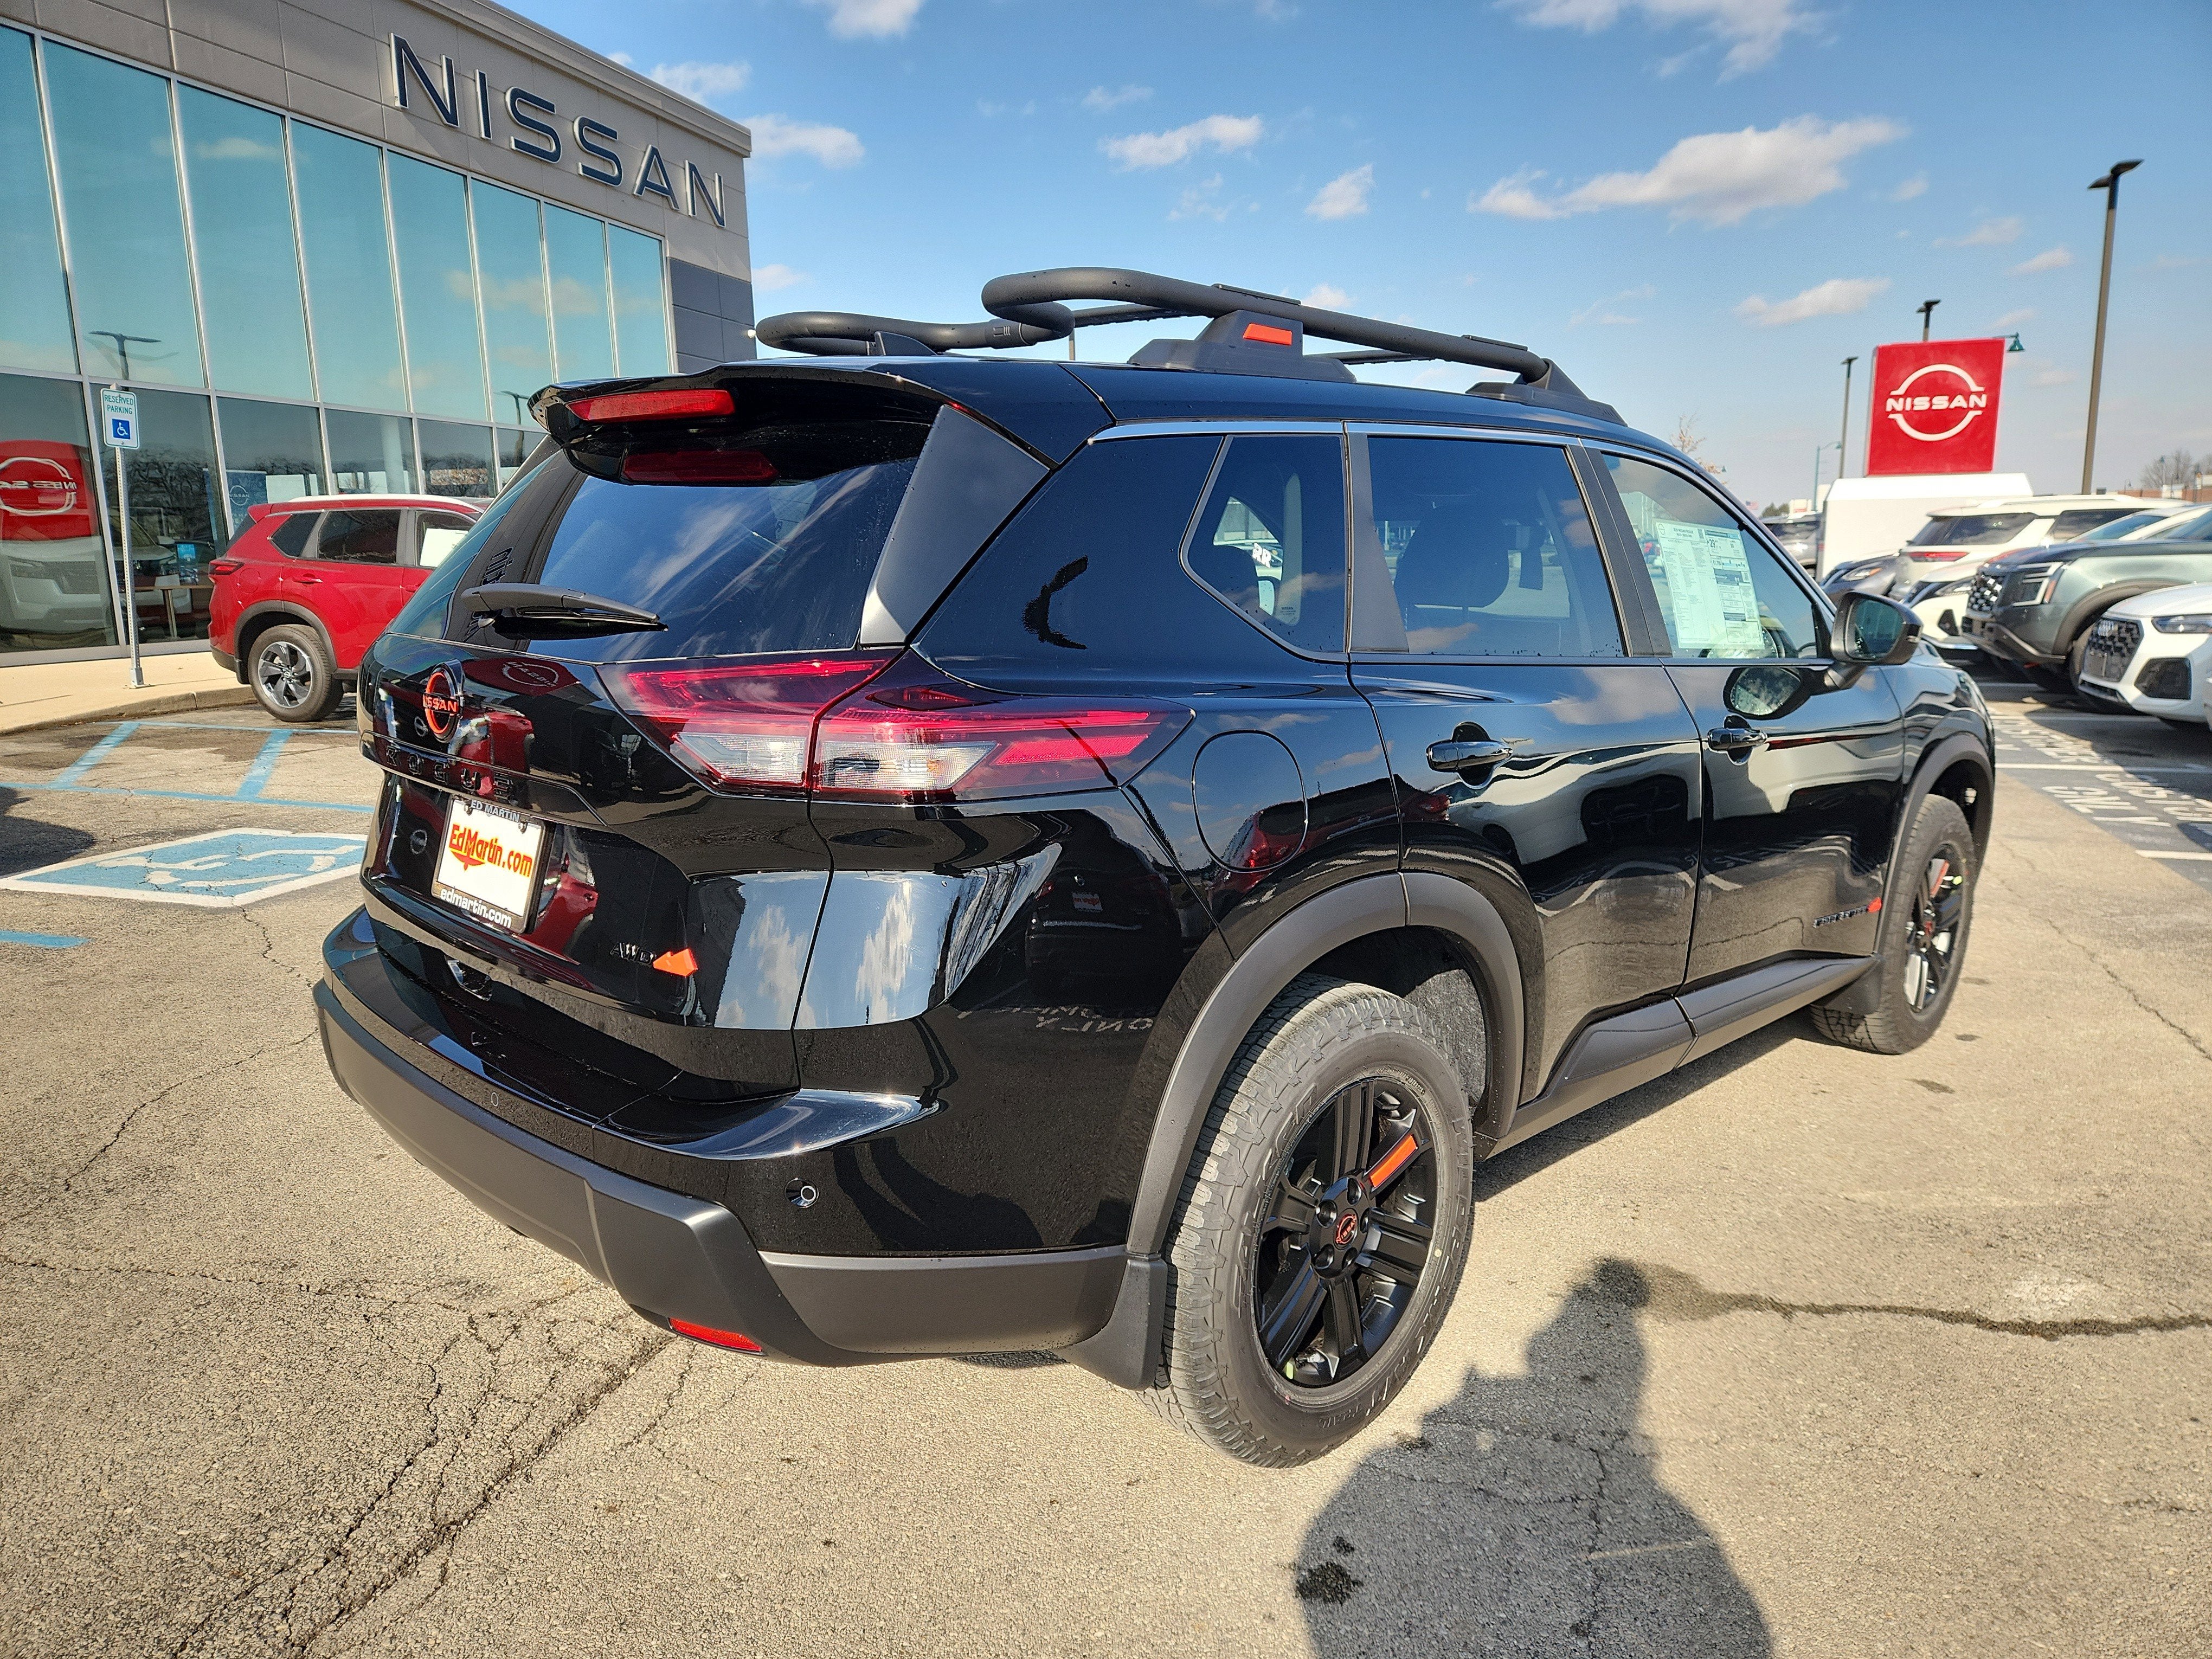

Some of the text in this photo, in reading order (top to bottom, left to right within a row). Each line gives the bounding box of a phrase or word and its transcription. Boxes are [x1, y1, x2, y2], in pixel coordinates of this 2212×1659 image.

[388, 31, 726, 228] NISSAN
[104, 394, 134, 406] RESERVED
[107, 404, 133, 415] PARKING
[1886, 394, 1987, 411] NISSAN
[385, 745, 515, 804] ROGUE
[470, 800, 520, 823] ED MARTIN
[2042, 786, 2171, 827] ONLY
[448, 823, 532, 878] EdMartin.com
[440, 888, 512, 929] edmartin.com
[610, 941, 656, 966] AWD
